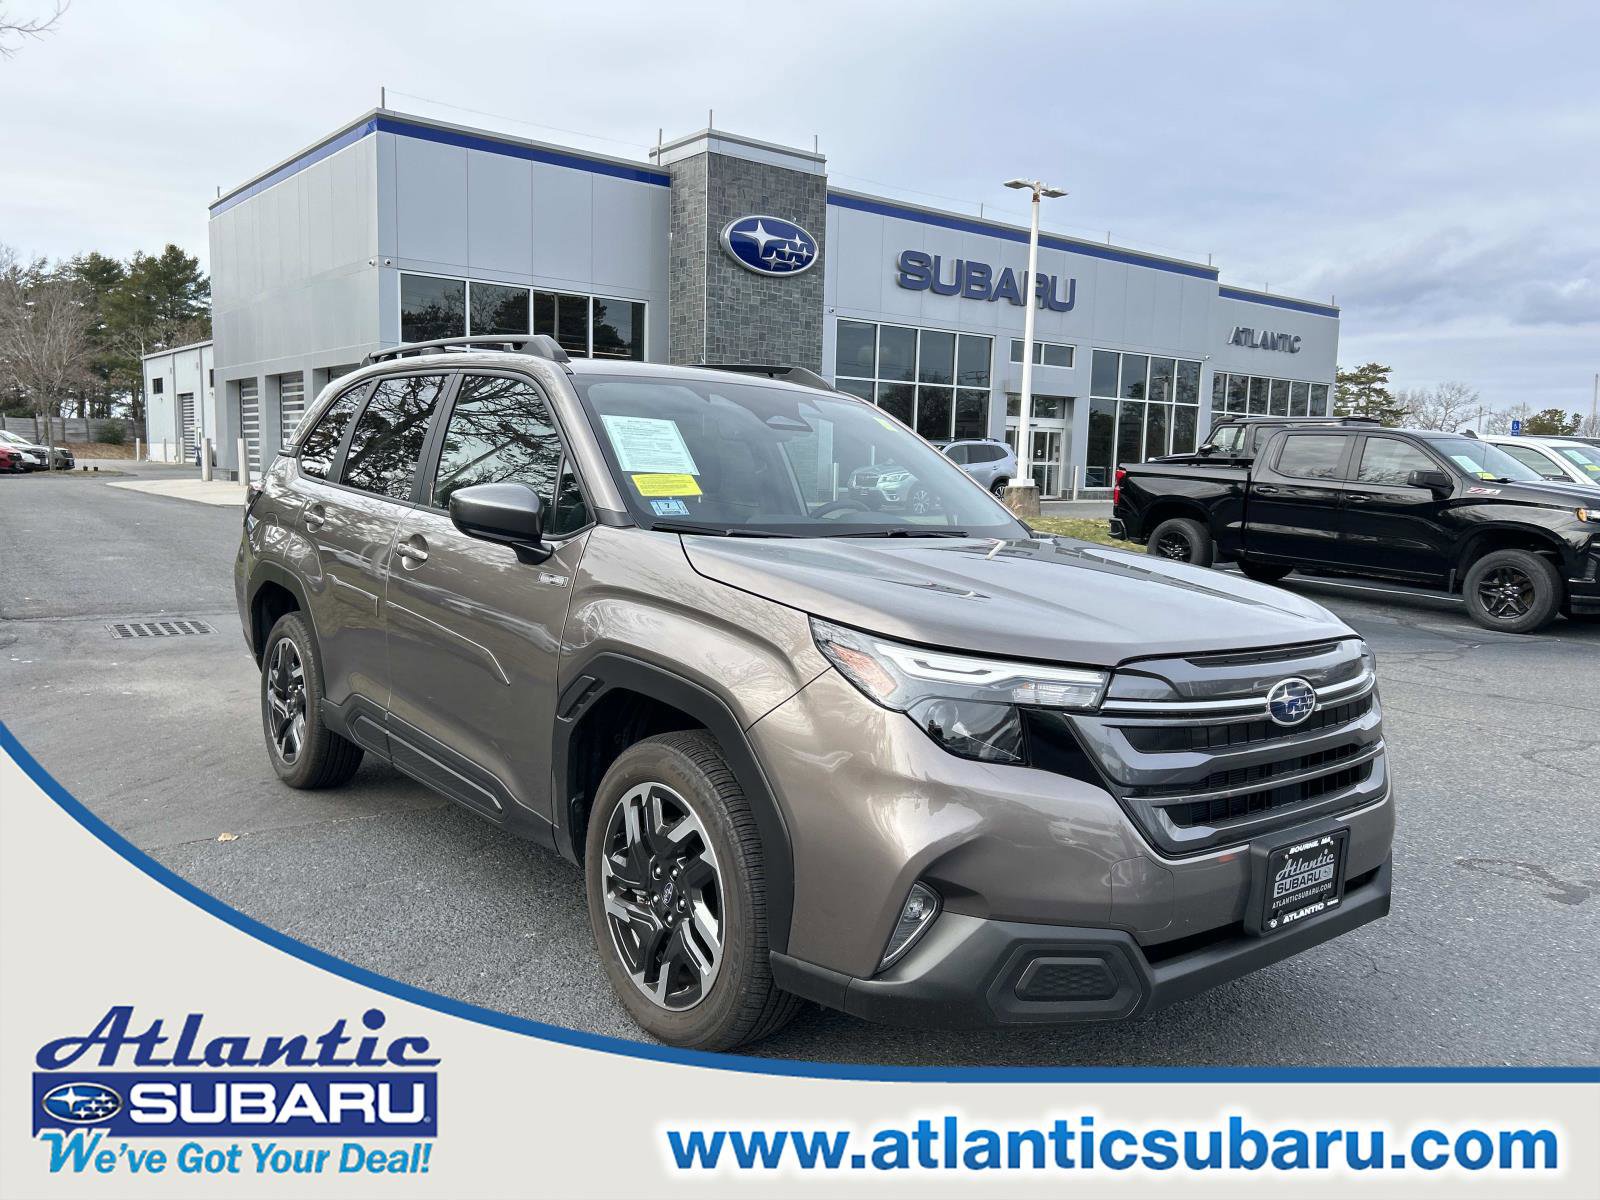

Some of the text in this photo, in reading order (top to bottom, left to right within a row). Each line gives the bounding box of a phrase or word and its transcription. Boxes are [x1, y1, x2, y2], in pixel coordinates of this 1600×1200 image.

[898, 250, 1076, 312] SUBARU
[1228, 327, 1301, 353] ATLANTIC
[1276, 849, 1335, 881] Atlantic
[1276, 869, 1321, 895] SUBARU
[1272, 882, 1332, 909] ATLANTICSUBARU.COM
[1283, 903, 1325, 924] ATLANTIC
